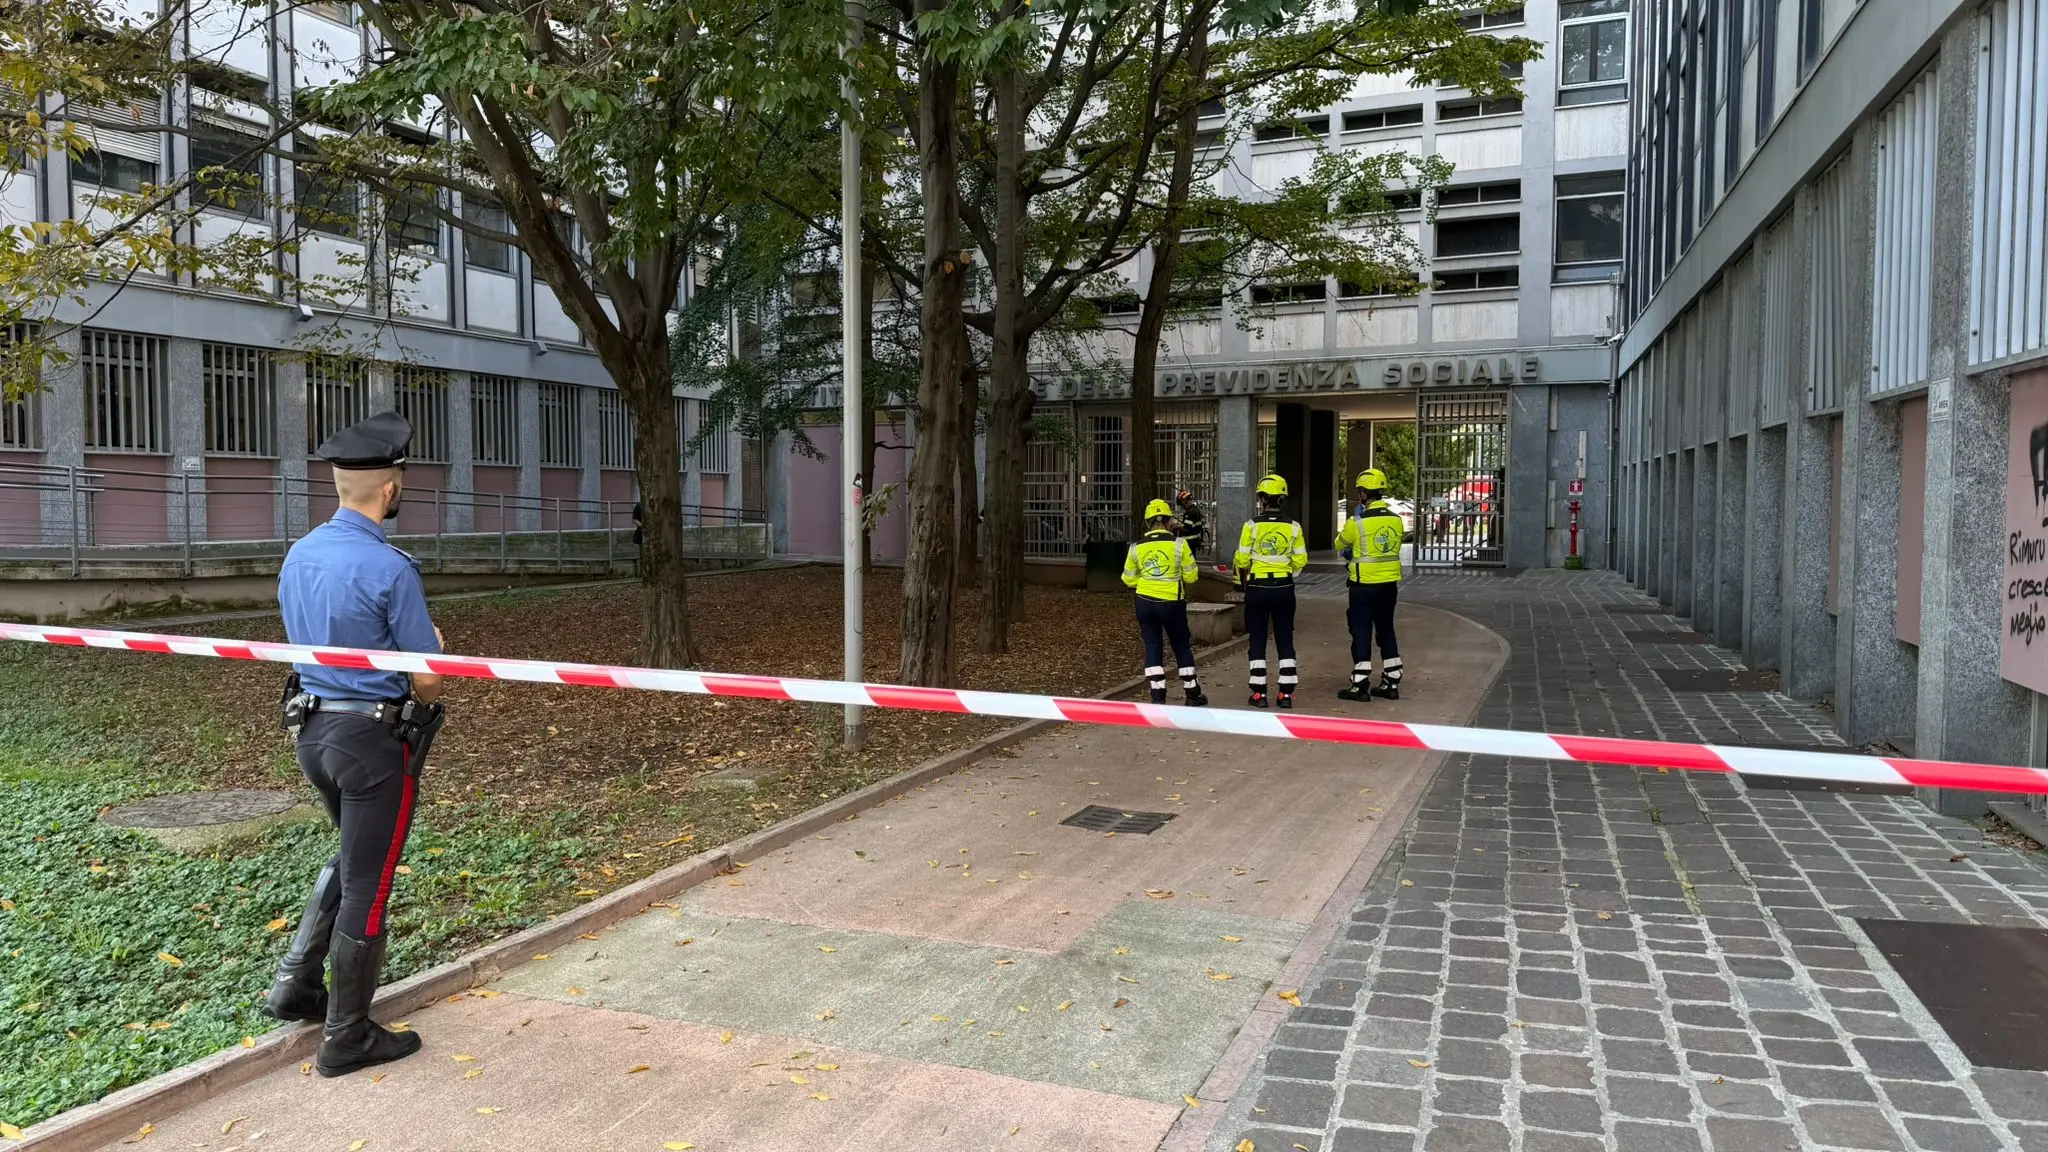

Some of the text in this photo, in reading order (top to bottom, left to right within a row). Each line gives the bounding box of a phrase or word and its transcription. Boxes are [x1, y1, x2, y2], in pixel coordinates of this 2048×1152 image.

[1061, 377, 1133, 397] DELL
[1160, 363, 1359, 394] PREVIDENZA
[1383, 356, 1541, 384] SOCIALE
